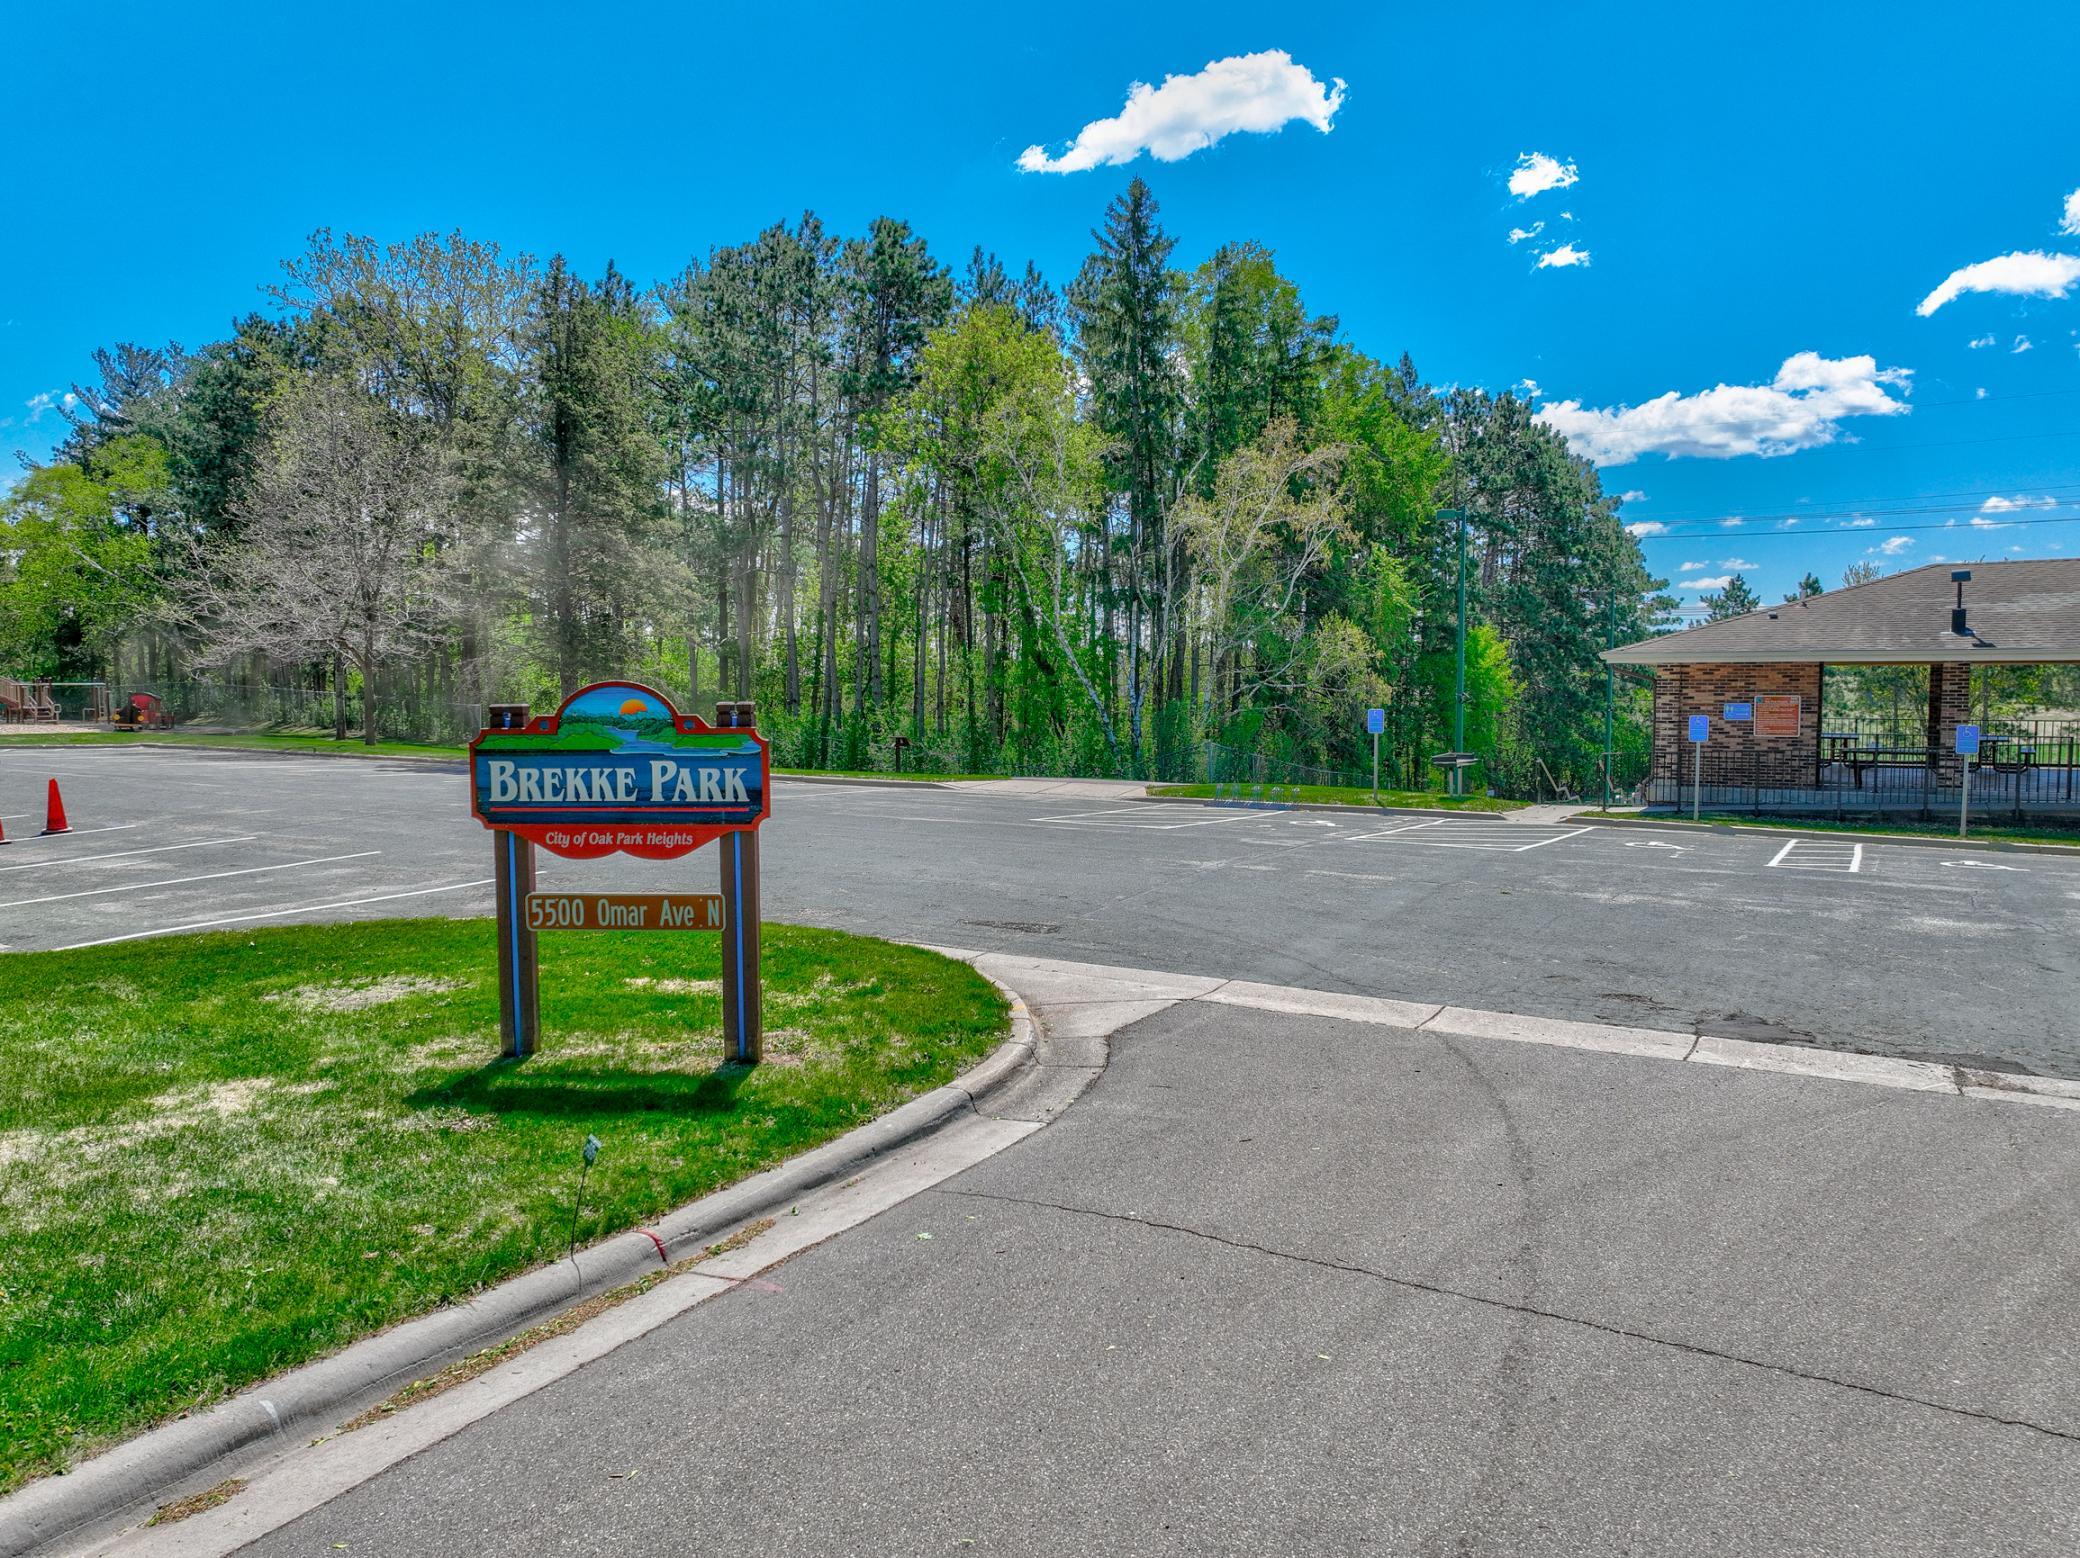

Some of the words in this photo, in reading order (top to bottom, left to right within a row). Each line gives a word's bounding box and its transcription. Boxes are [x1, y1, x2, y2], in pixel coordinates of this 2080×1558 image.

[488, 760, 638, 802] BREKKE
[649, 760, 750, 802] PARK
[545, 832, 570, 848] City
[573, 832, 587, 848] of
[589, 832, 613, 845] Oak
[616, 832, 643, 845] Park
[646, 832, 693, 848] Heights
[531, 898, 585, 927] 5500
[597, 898, 647, 927] Omar
[659, 898, 695, 927] Ave
[707, 898, 720, 927] N
